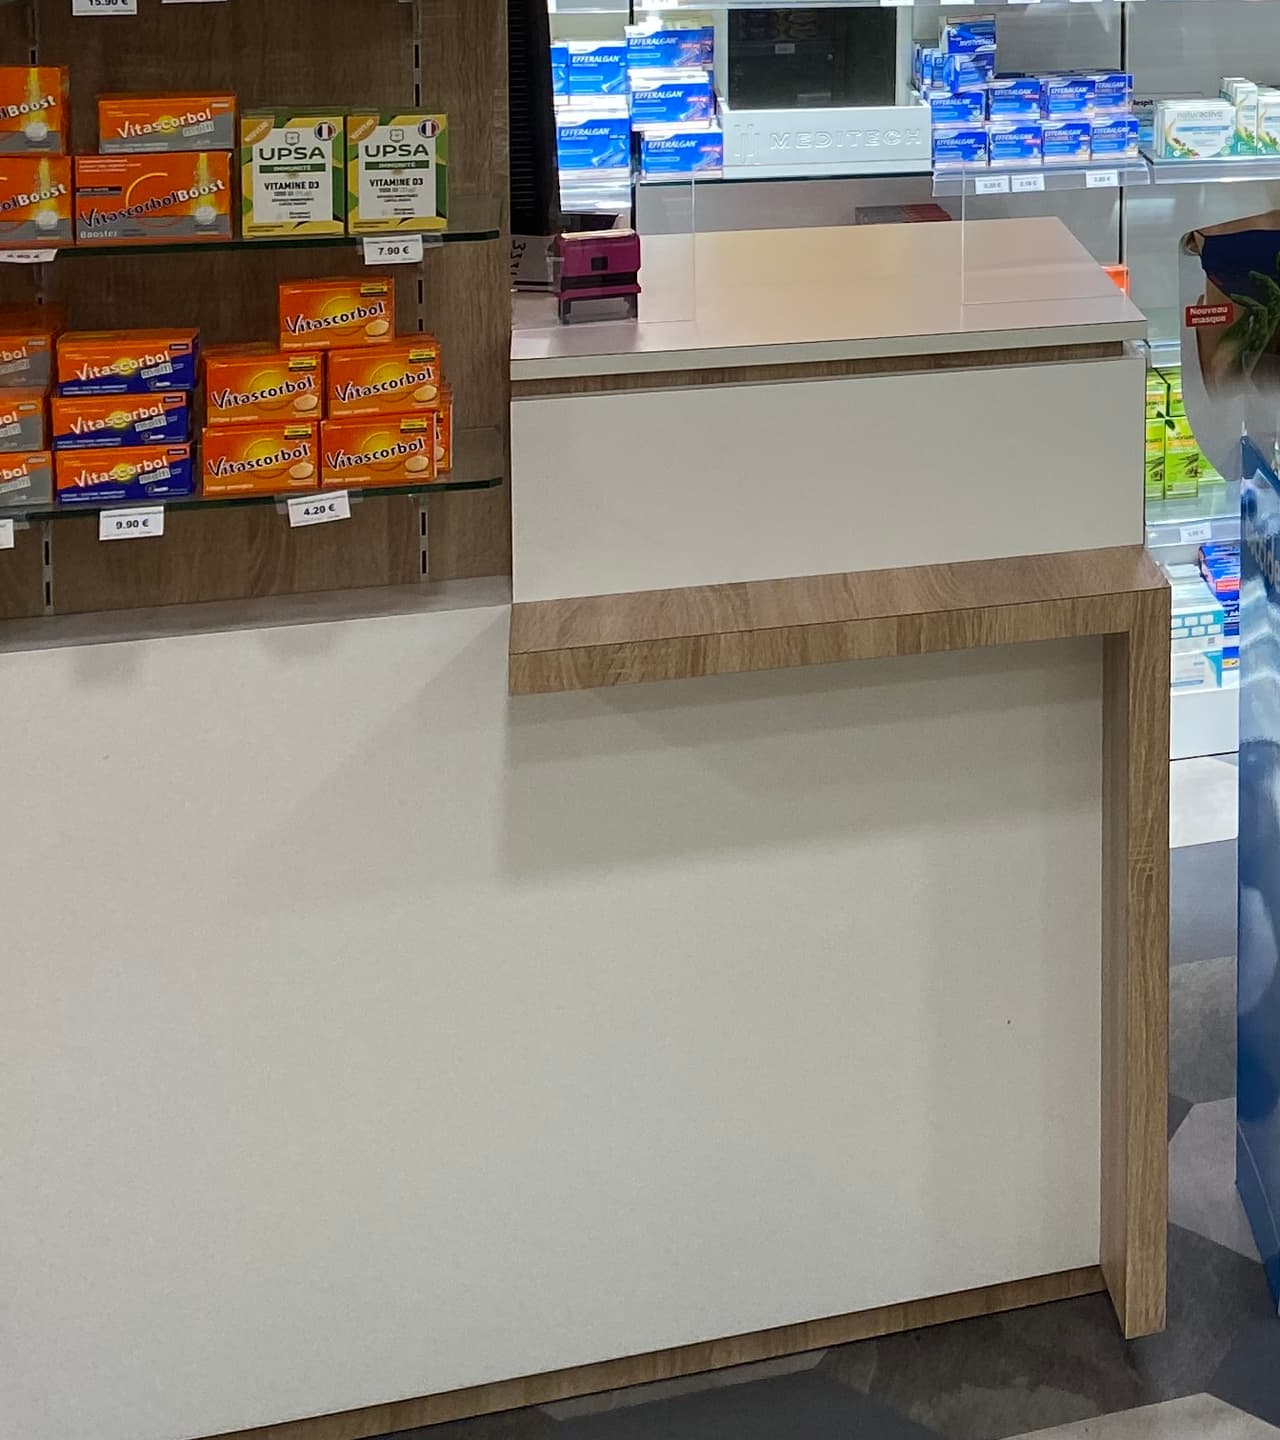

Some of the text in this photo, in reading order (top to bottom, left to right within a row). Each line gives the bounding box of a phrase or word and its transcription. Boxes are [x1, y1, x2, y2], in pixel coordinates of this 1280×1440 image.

[629, 37, 676, 45] EFFERALGAN
[572, 55, 620, 63] EFFERALGAN
[116, 108, 212, 139] Vitascorbol
[259, 147, 325, 161] UPSA
[365, 144, 429, 158] UPSA
[264, 181, 319, 191] VITAMINE D3
[369, 178, 423, 187] VITAMINE D3
[378, 246, 409, 255] 7.90 €
[286, 301, 384, 336] Vitascorbol
[75, 351, 170, 381] Vitascorbol
[212, 376, 313, 409] Vitascorbol
[336, 367, 432, 402] Vitascorbol
[70, 403, 165, 435] Vitascorbol
[208, 444, 309, 478] Vitascorbol
[327, 438, 424, 470] Vitascorbol
[74, 456, 168, 487] Vitascorbol
[304, 503, 335, 516] 4.20 €
[116, 519, 149, 529] 9.90 €
